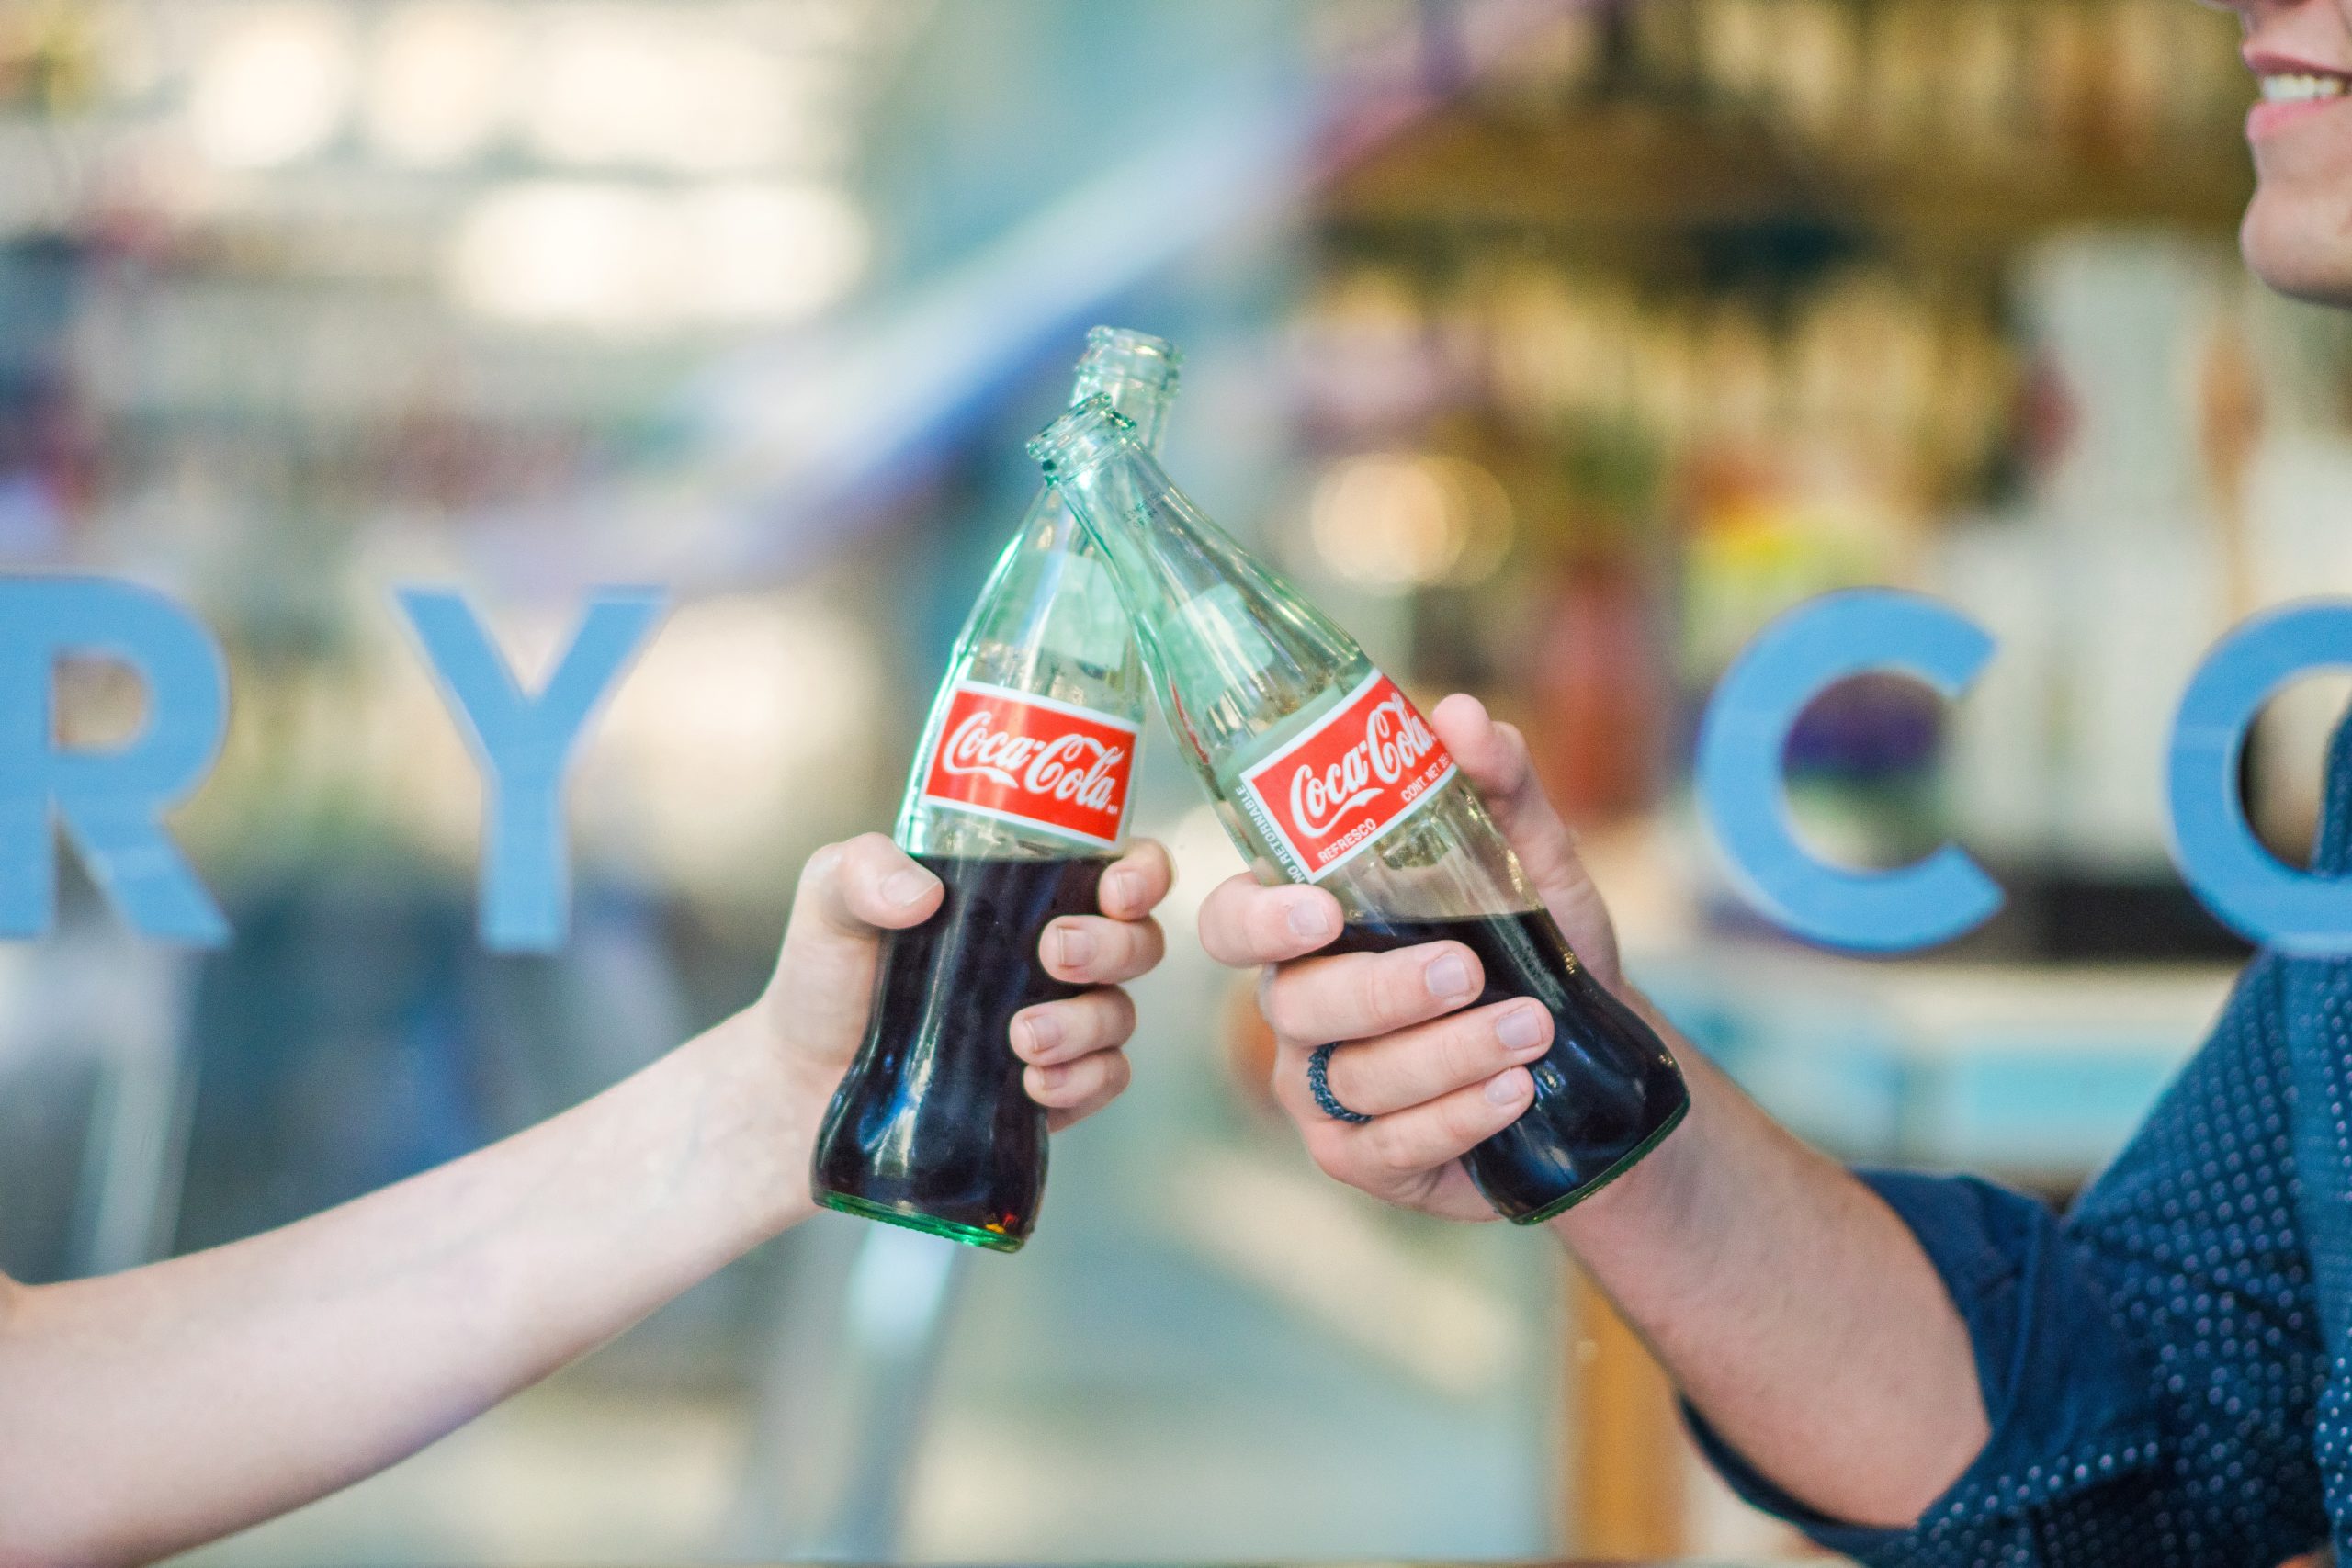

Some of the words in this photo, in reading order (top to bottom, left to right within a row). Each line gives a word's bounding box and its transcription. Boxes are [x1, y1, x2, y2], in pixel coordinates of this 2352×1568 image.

[942, 711, 1124, 812] Coca-Cola
[1289, 692, 1434, 838] Coca-Cola
[1235, 785, 1291, 865] RETORNABLE
[1317, 818, 1376, 863] REFRESCO
[1425, 762, 1442, 781] NET
